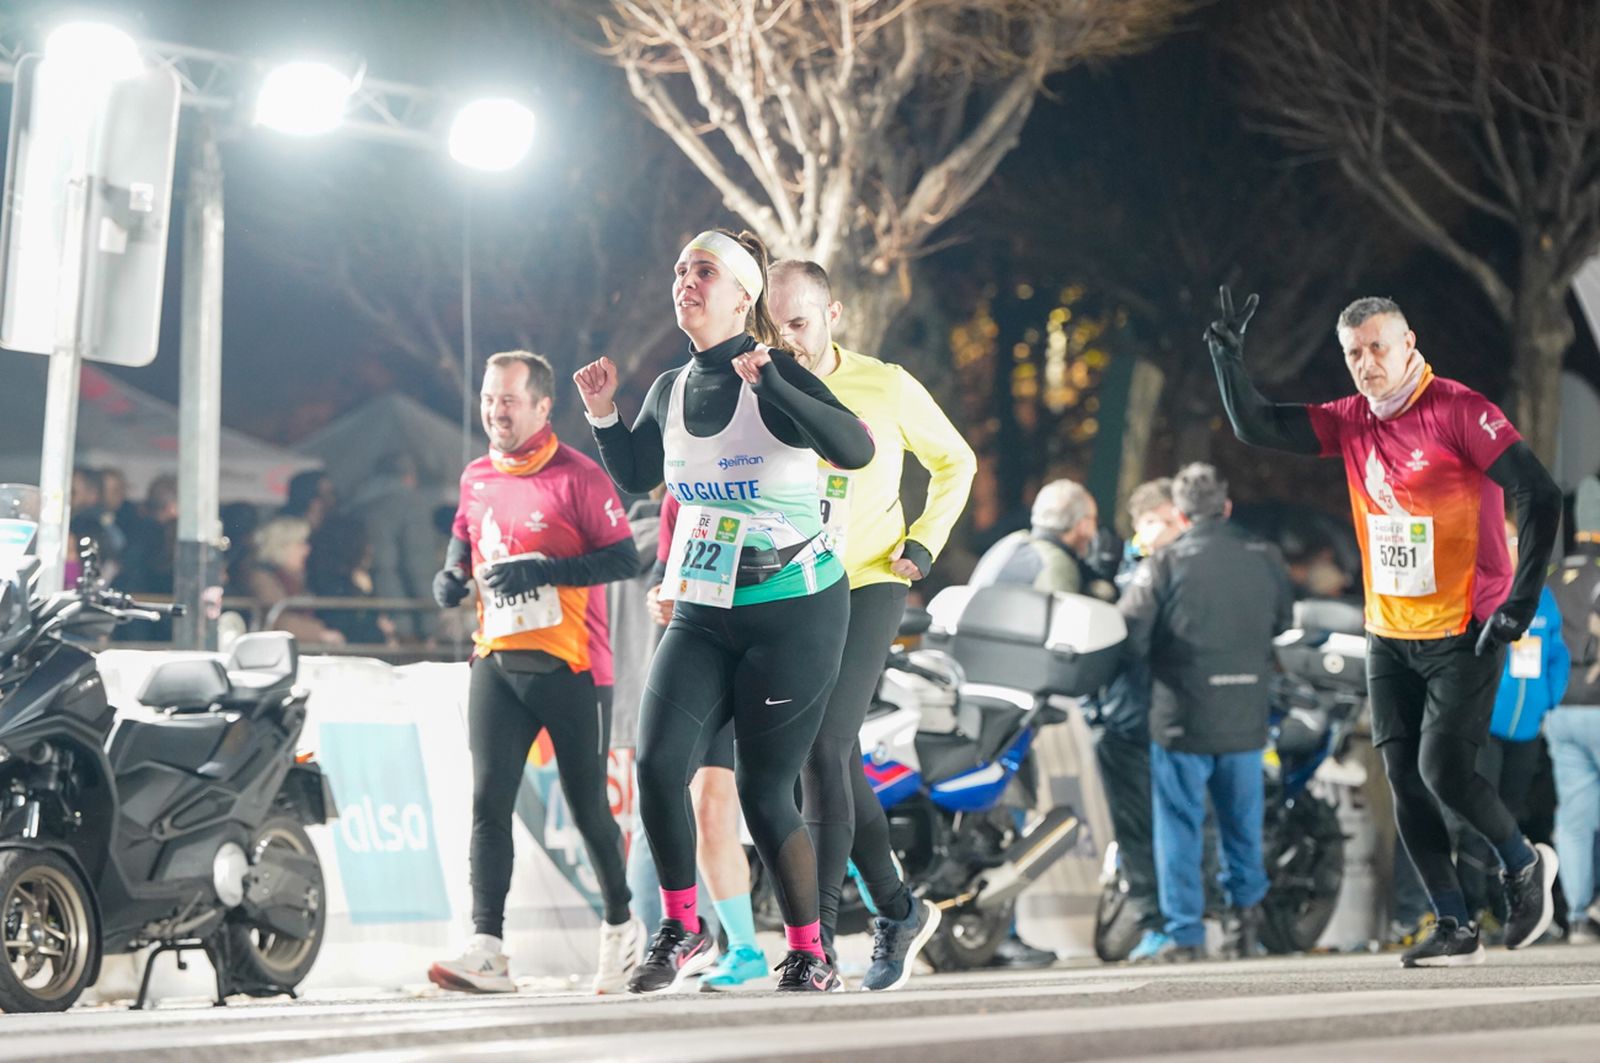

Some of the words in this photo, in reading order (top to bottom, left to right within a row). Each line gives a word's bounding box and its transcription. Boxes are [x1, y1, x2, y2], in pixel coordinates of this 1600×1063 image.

[694, 480, 761, 501] GILETE
[1380, 545, 1417, 568] 5251
[340, 795, 428, 852] alsa
